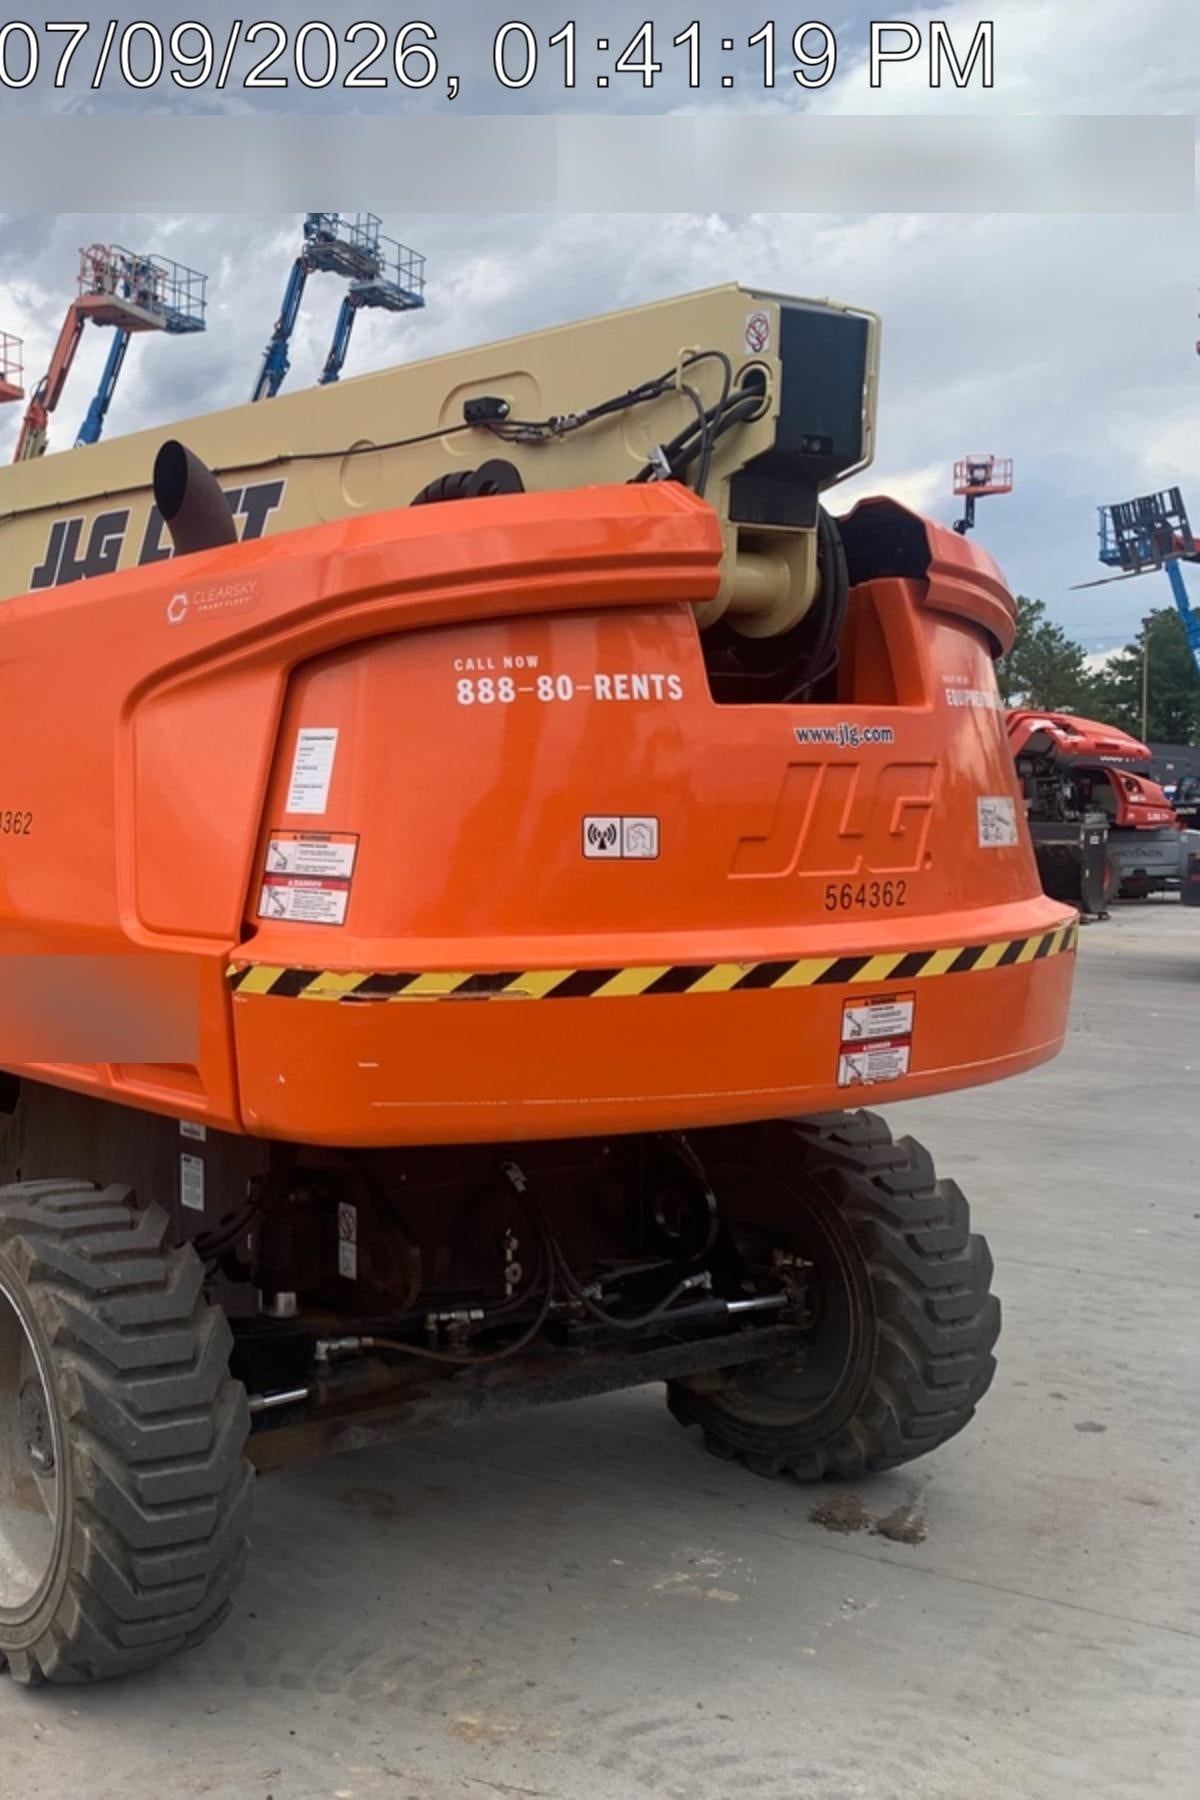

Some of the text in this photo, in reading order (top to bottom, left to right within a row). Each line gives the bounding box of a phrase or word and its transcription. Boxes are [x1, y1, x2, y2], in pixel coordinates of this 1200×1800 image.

[28, 508, 131, 592] JLG
[453, 655, 539, 672] CALL NOW
[456, 674, 684, 705] 888-80-RENTS
[794, 723, 894, 748] www.jlg.com
[728, 761, 938, 880] JLG
[825, 880, 907, 911] 564362
